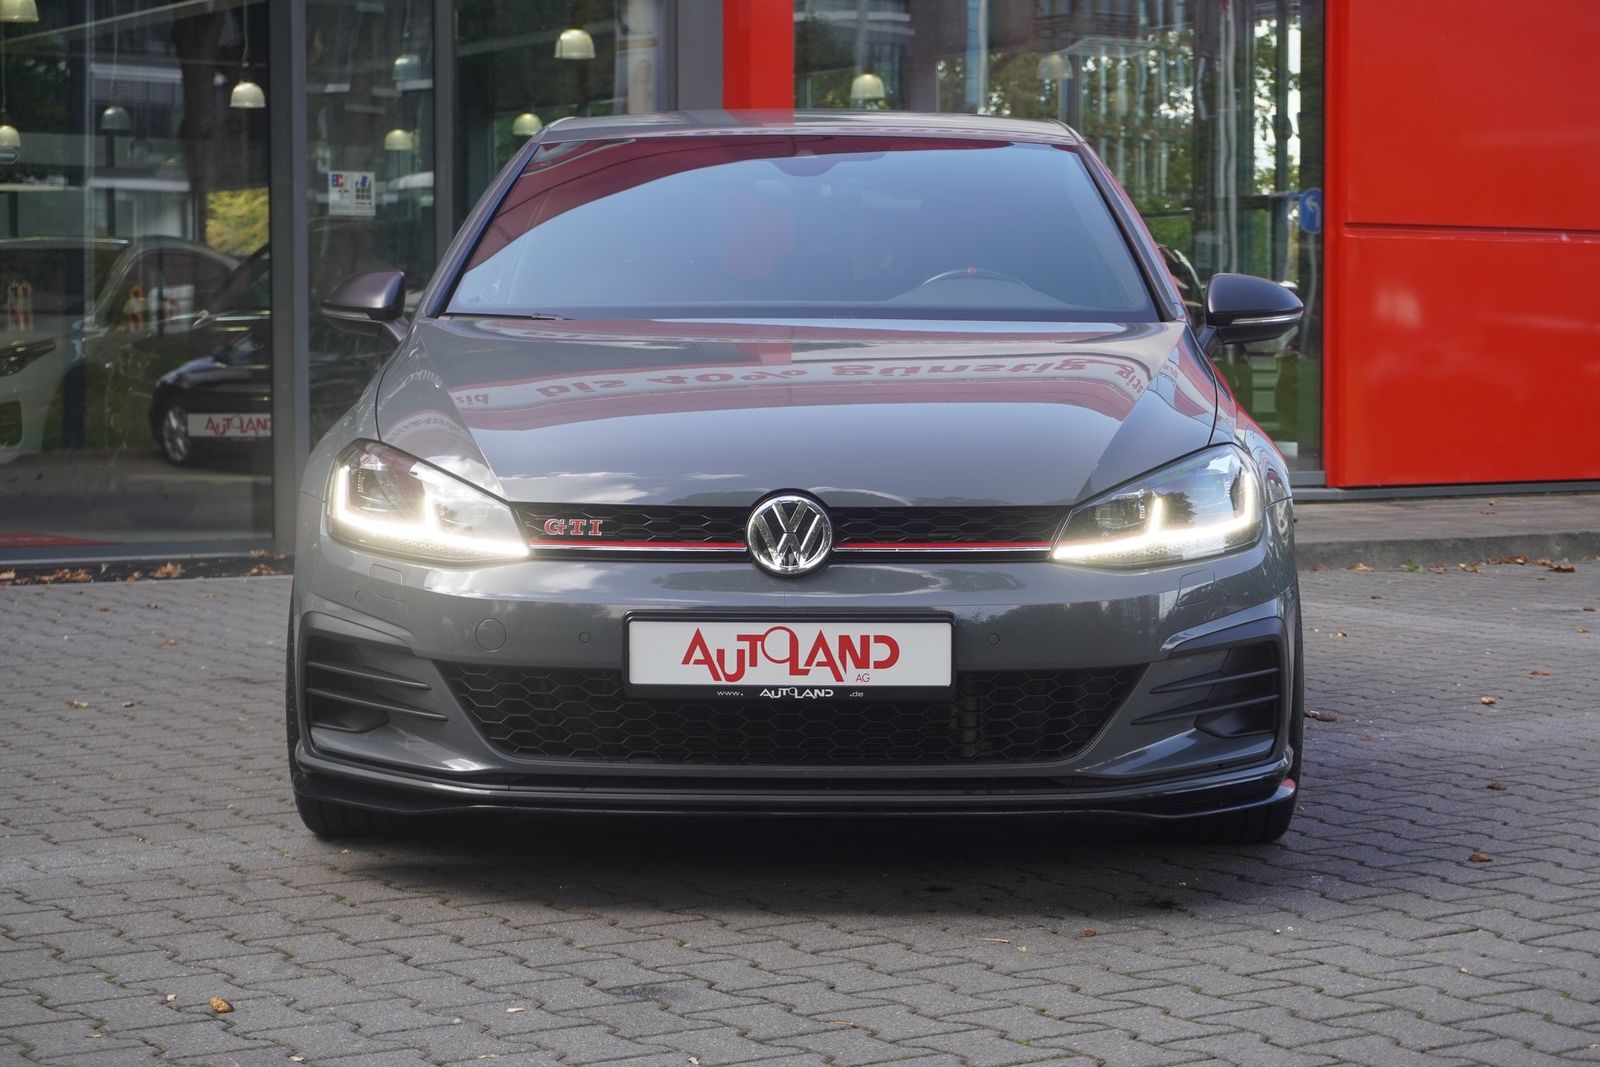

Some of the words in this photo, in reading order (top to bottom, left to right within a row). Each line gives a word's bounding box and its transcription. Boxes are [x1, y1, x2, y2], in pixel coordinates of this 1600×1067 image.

[543, 518, 603, 536] GTI
[681, 626, 900, 683] AUTOLAND
[855, 673, 871, 683] AG
[759, 686, 834, 699] AUTOLAND
